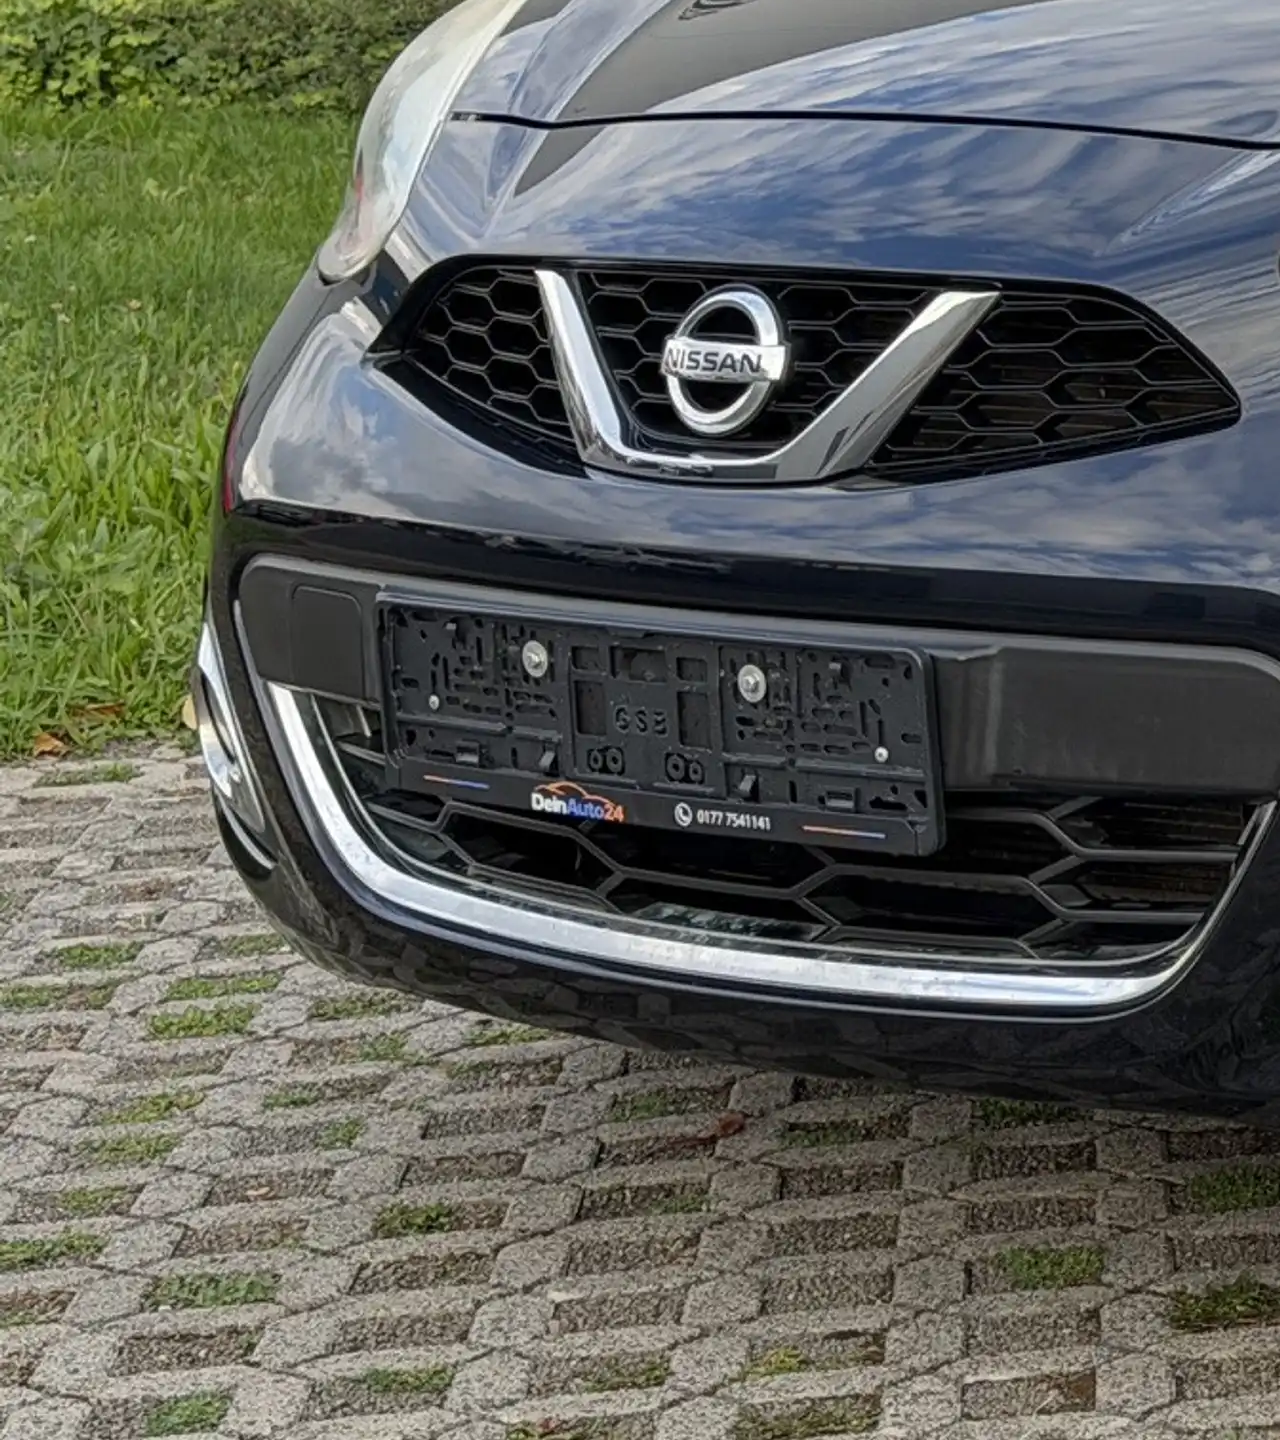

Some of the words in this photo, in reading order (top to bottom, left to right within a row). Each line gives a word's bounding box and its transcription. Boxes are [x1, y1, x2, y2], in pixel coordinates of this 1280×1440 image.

[664, 347, 763, 374] NISSAN
[530, 791, 625, 823] DeinAuto24
[696, 809, 724, 826] 0177
